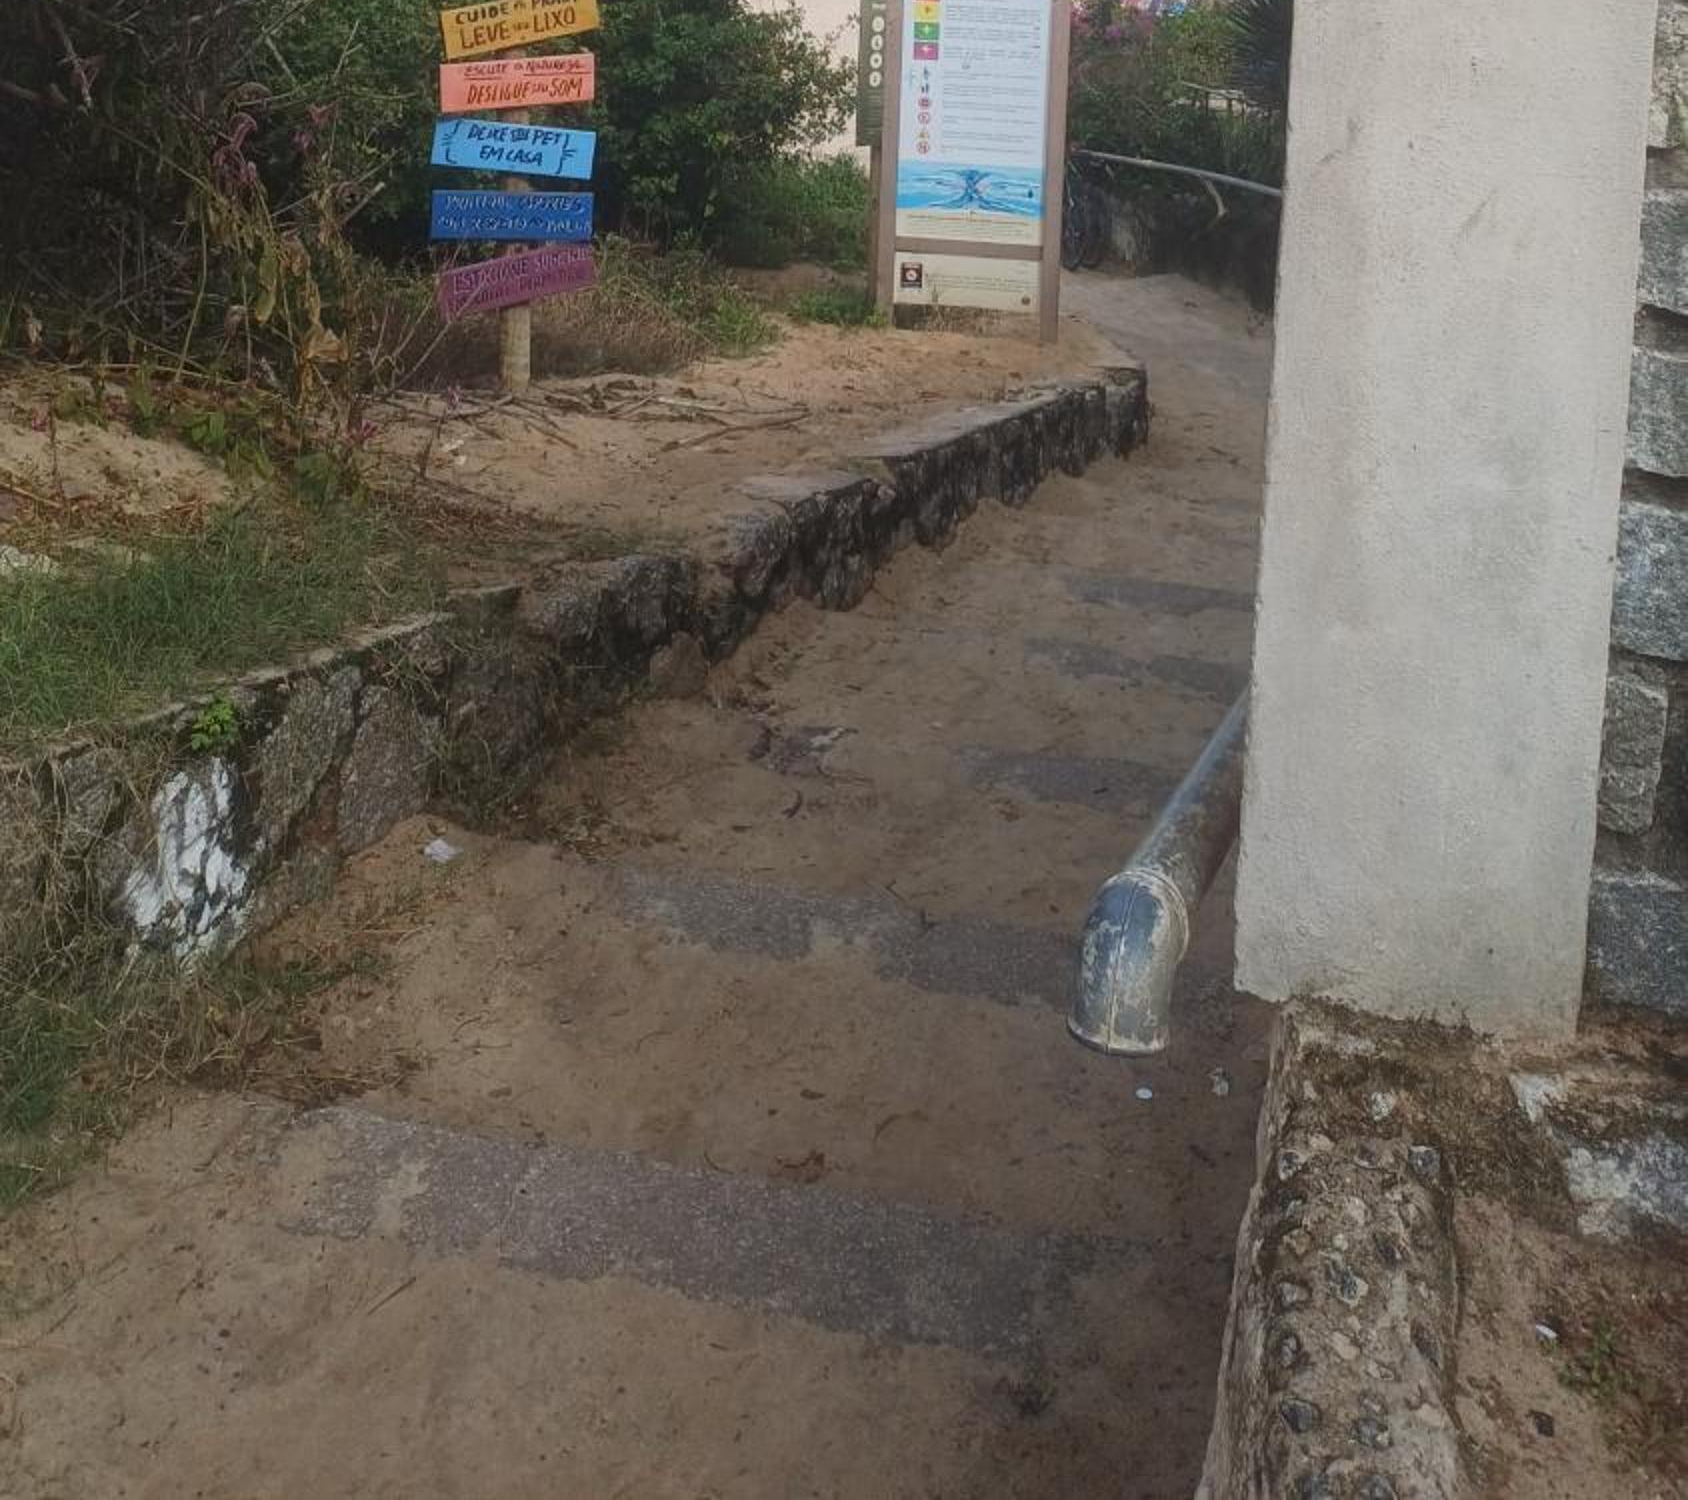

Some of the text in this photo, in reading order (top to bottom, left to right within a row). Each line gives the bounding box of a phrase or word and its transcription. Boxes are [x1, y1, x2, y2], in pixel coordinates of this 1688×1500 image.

[455, 2, 509, 25] CUIDE
[460, 20, 511, 49] LEVE
[533, 5, 576, 33] LIXO
[550, 77, 583, 98] SOM
[468, 124, 510, 142] DEIXE
[532, 129, 561, 146] PET
[479, 145, 543, 165] EM CASA
